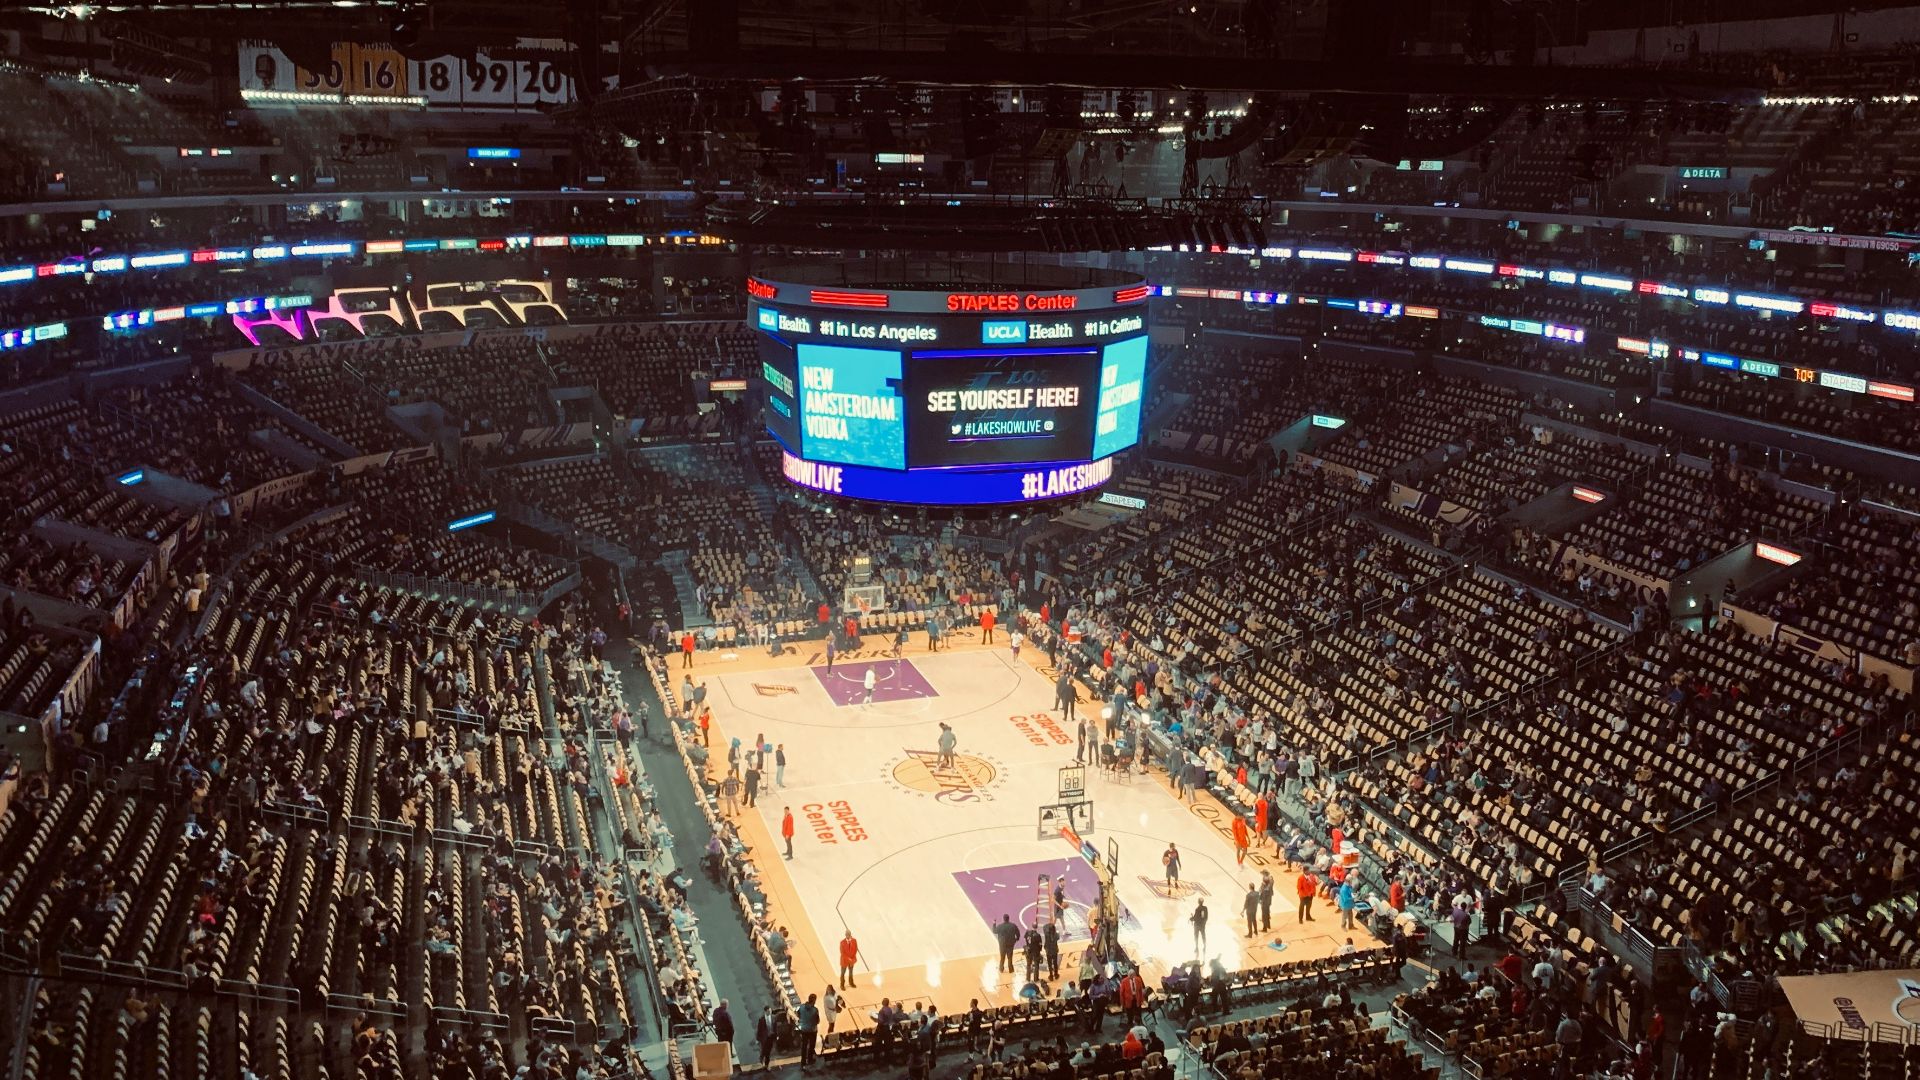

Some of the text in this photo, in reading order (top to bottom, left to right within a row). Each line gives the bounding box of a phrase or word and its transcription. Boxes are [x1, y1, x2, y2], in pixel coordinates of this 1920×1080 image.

[363, 60, 395, 89] 16
[418, 61, 449, 91] 18
[468, 62, 508, 92] 99
[523, 64, 562, 94] 20
[1692, 169, 1721, 178] DELTA
[287, 297, 311, 305] DELTA
[947, 293, 1077, 311] STAPLES Center
[779, 315, 811, 333] Health
[819, 321, 937, 342] #1 in Los Angeles
[988, 323, 1073, 340] UCLA Health
[1084, 316, 1142, 337] #1 in California
[1480, 315, 1509, 328] Spectrum
[803, 366, 834, 390] NEW
[1749, 363, 1777, 375] DELTA
[1821, 373, 1865, 391] STAPLES
[927, 387, 1080, 412] SEE YOURSELF HERE!
[806, 415, 849, 441] VODKA
[964, 420, 1041, 436] #LAKESHOWLIVE
[1105, 494, 1137, 506] STAPLES
[1009, 715, 1049, 746] Center
[1030, 713, 1074, 745] STAPLES
[802, 803, 838, 844] Center
[828, 800, 868, 842] STAPLES
